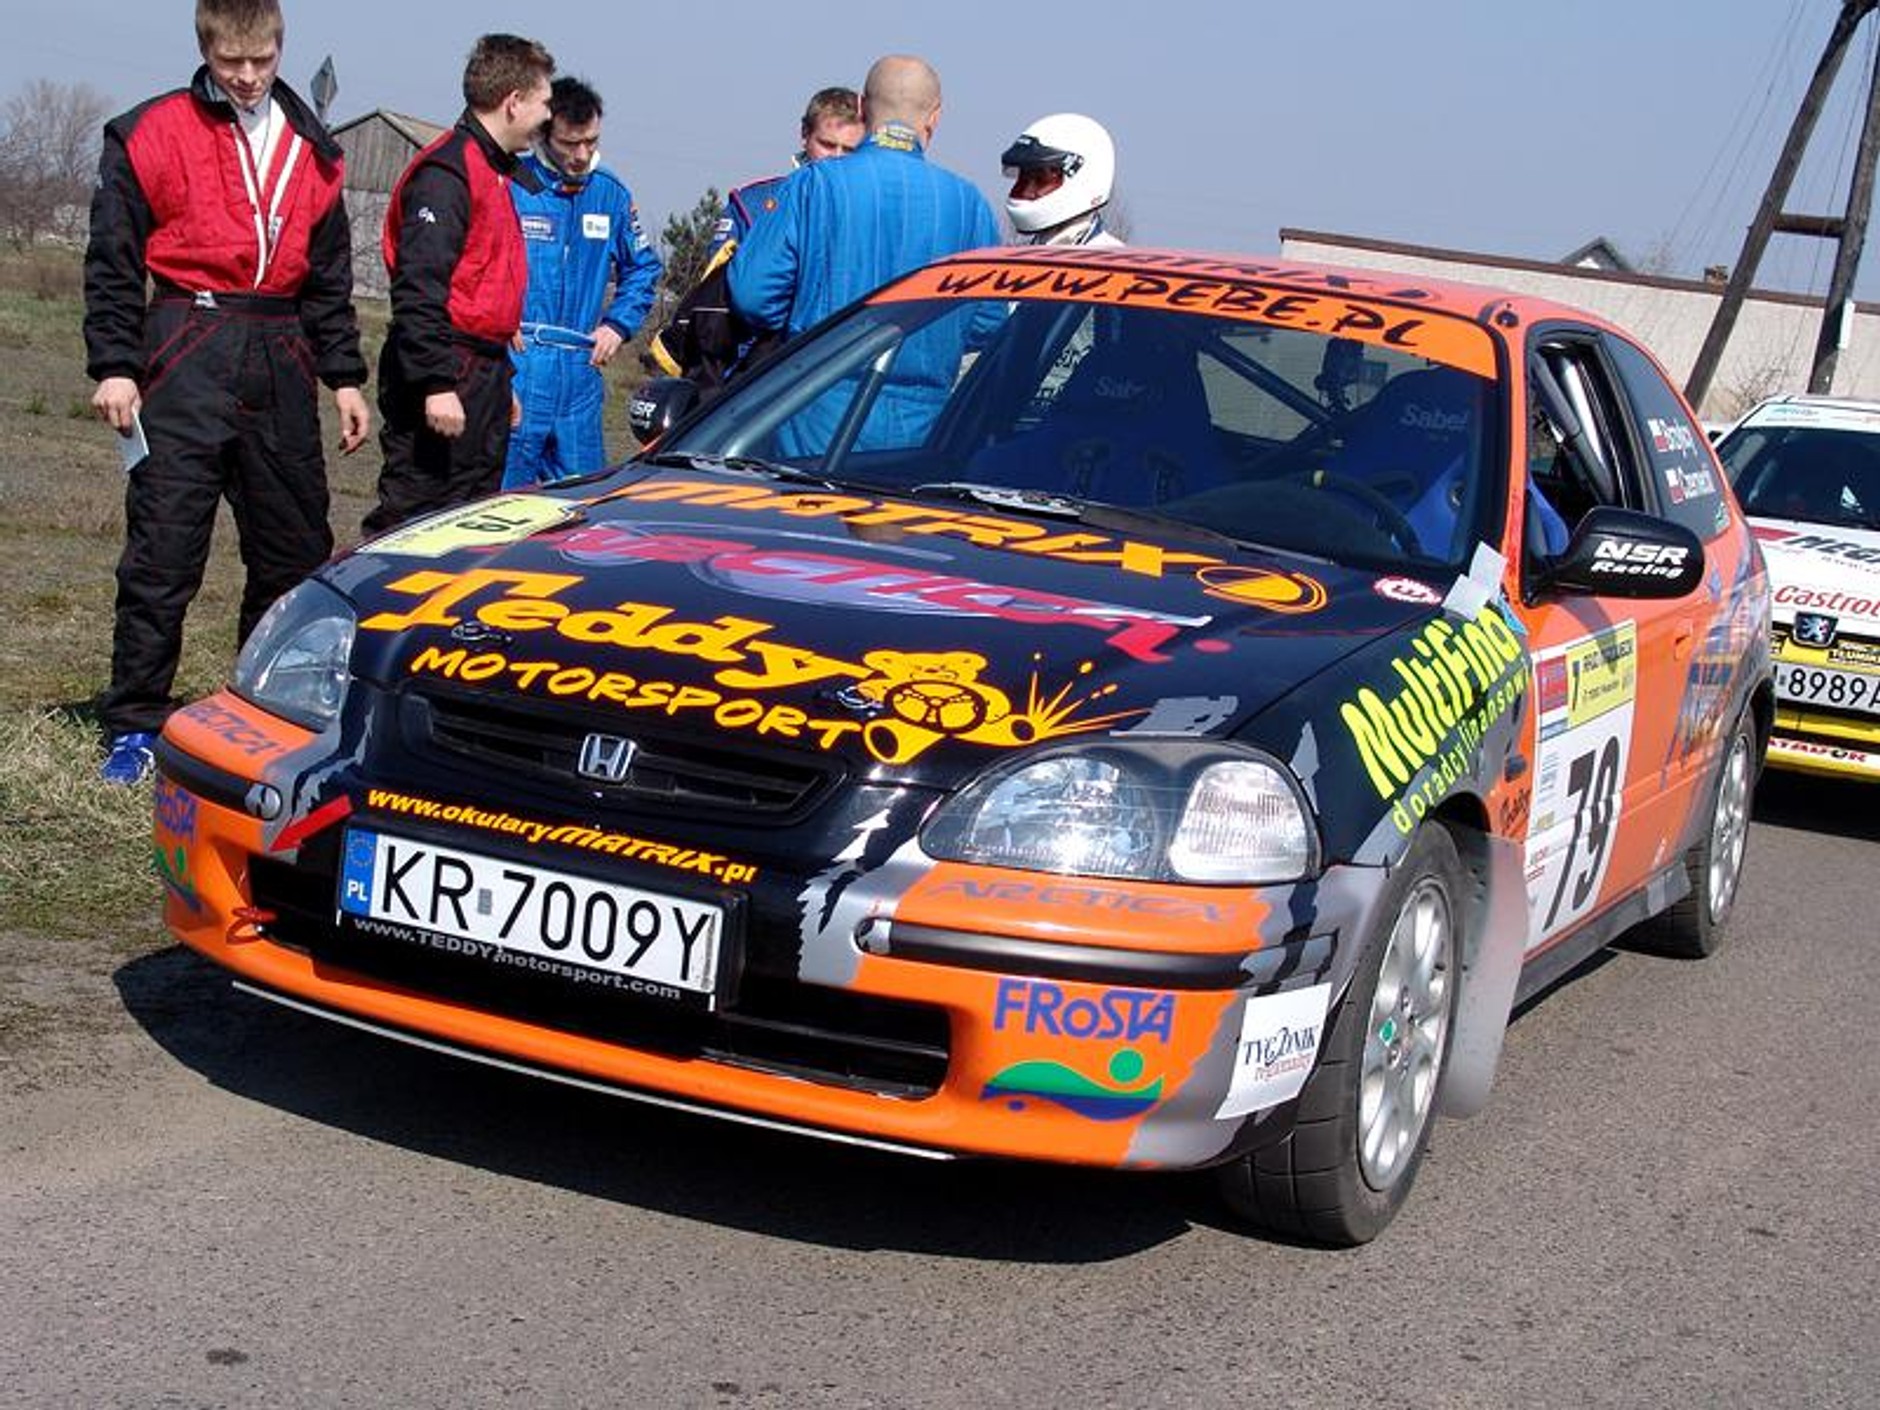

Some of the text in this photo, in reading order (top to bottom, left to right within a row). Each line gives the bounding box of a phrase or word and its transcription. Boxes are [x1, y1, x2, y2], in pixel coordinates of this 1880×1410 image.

[937, 268, 1426, 347] WWW.PEBE.PL
[1590, 560, 1684, 579] Racing
[1594, 540, 1688, 566] NSR
[358, 567, 876, 690] Teddy
[410, 645, 864, 751] MOTORSPORT
[1541, 735, 1621, 933] 79
[346, 879, 369, 902] PL
[382, 846, 710, 982] KR 7009Y
